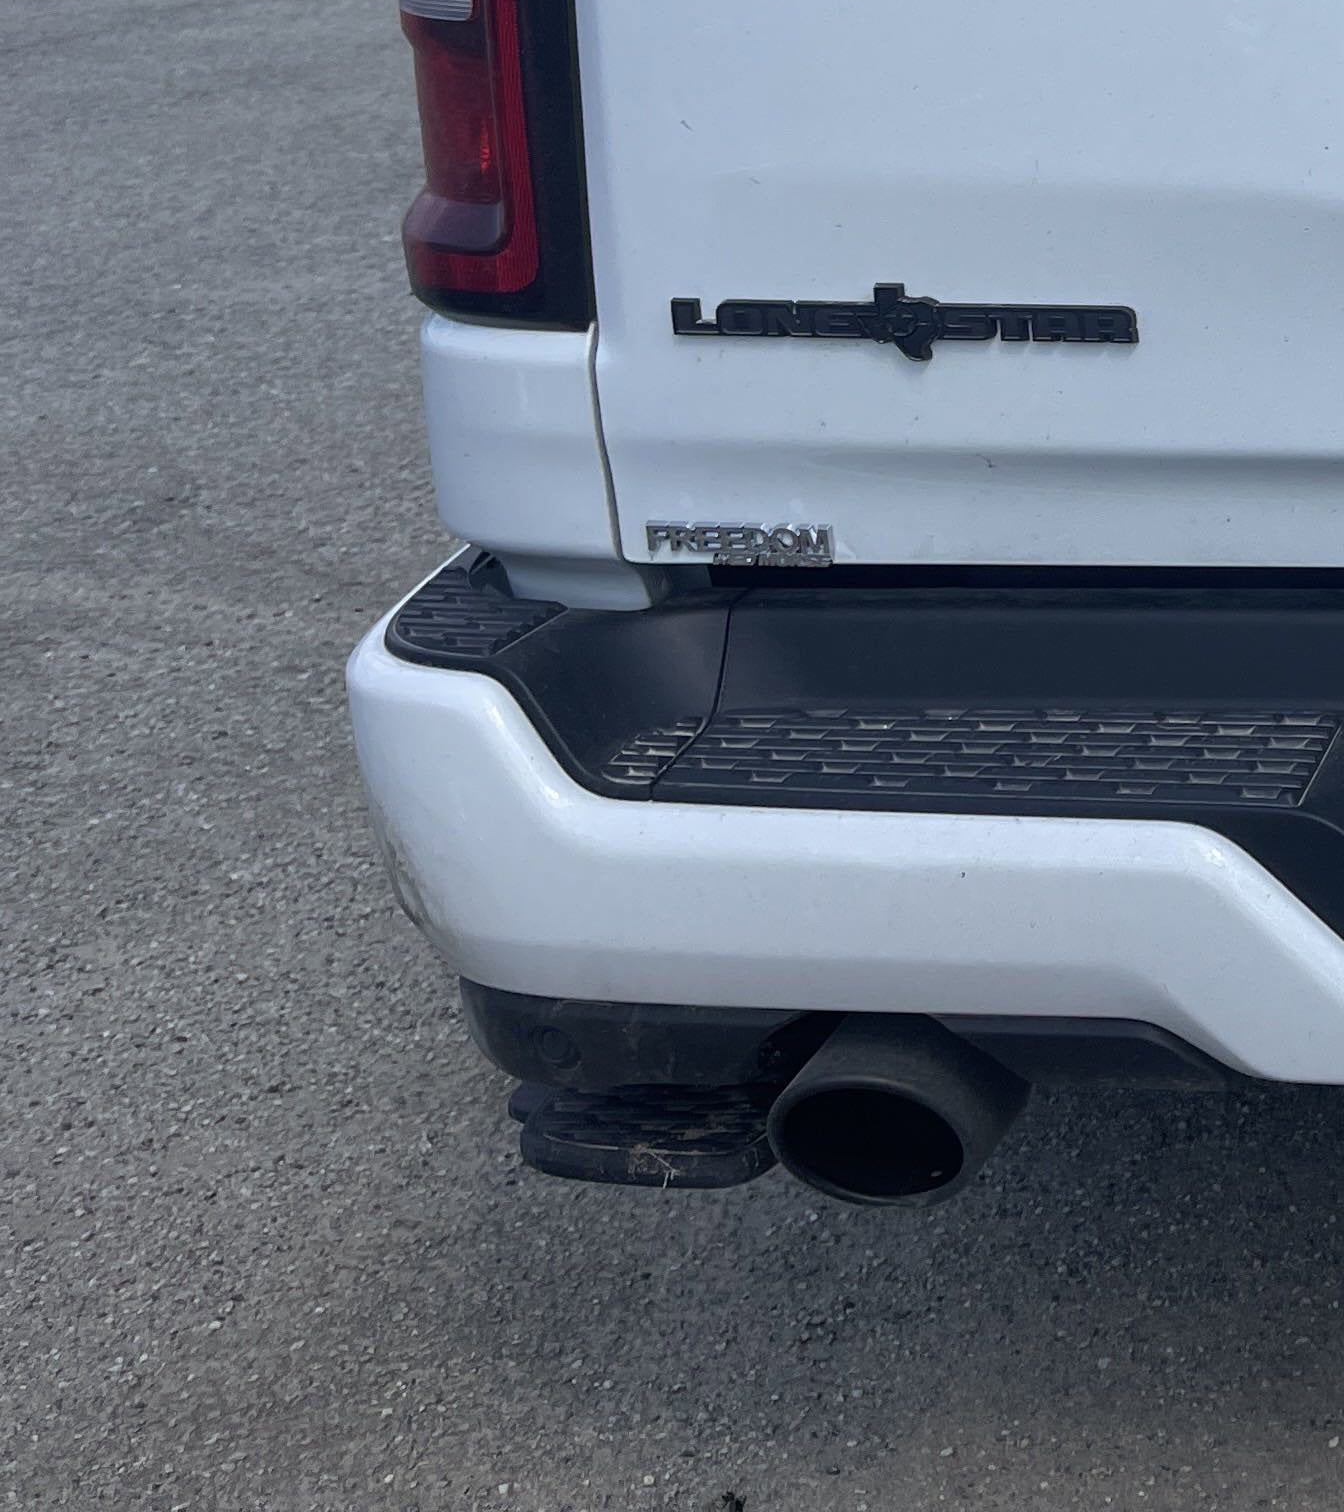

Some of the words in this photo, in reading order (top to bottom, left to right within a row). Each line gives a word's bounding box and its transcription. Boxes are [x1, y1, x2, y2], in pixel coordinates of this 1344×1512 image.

[671, 297, 868, 337] LONE
[938, 303, 1140, 343] STAR
[646, 520, 833, 554] FREEDOM
